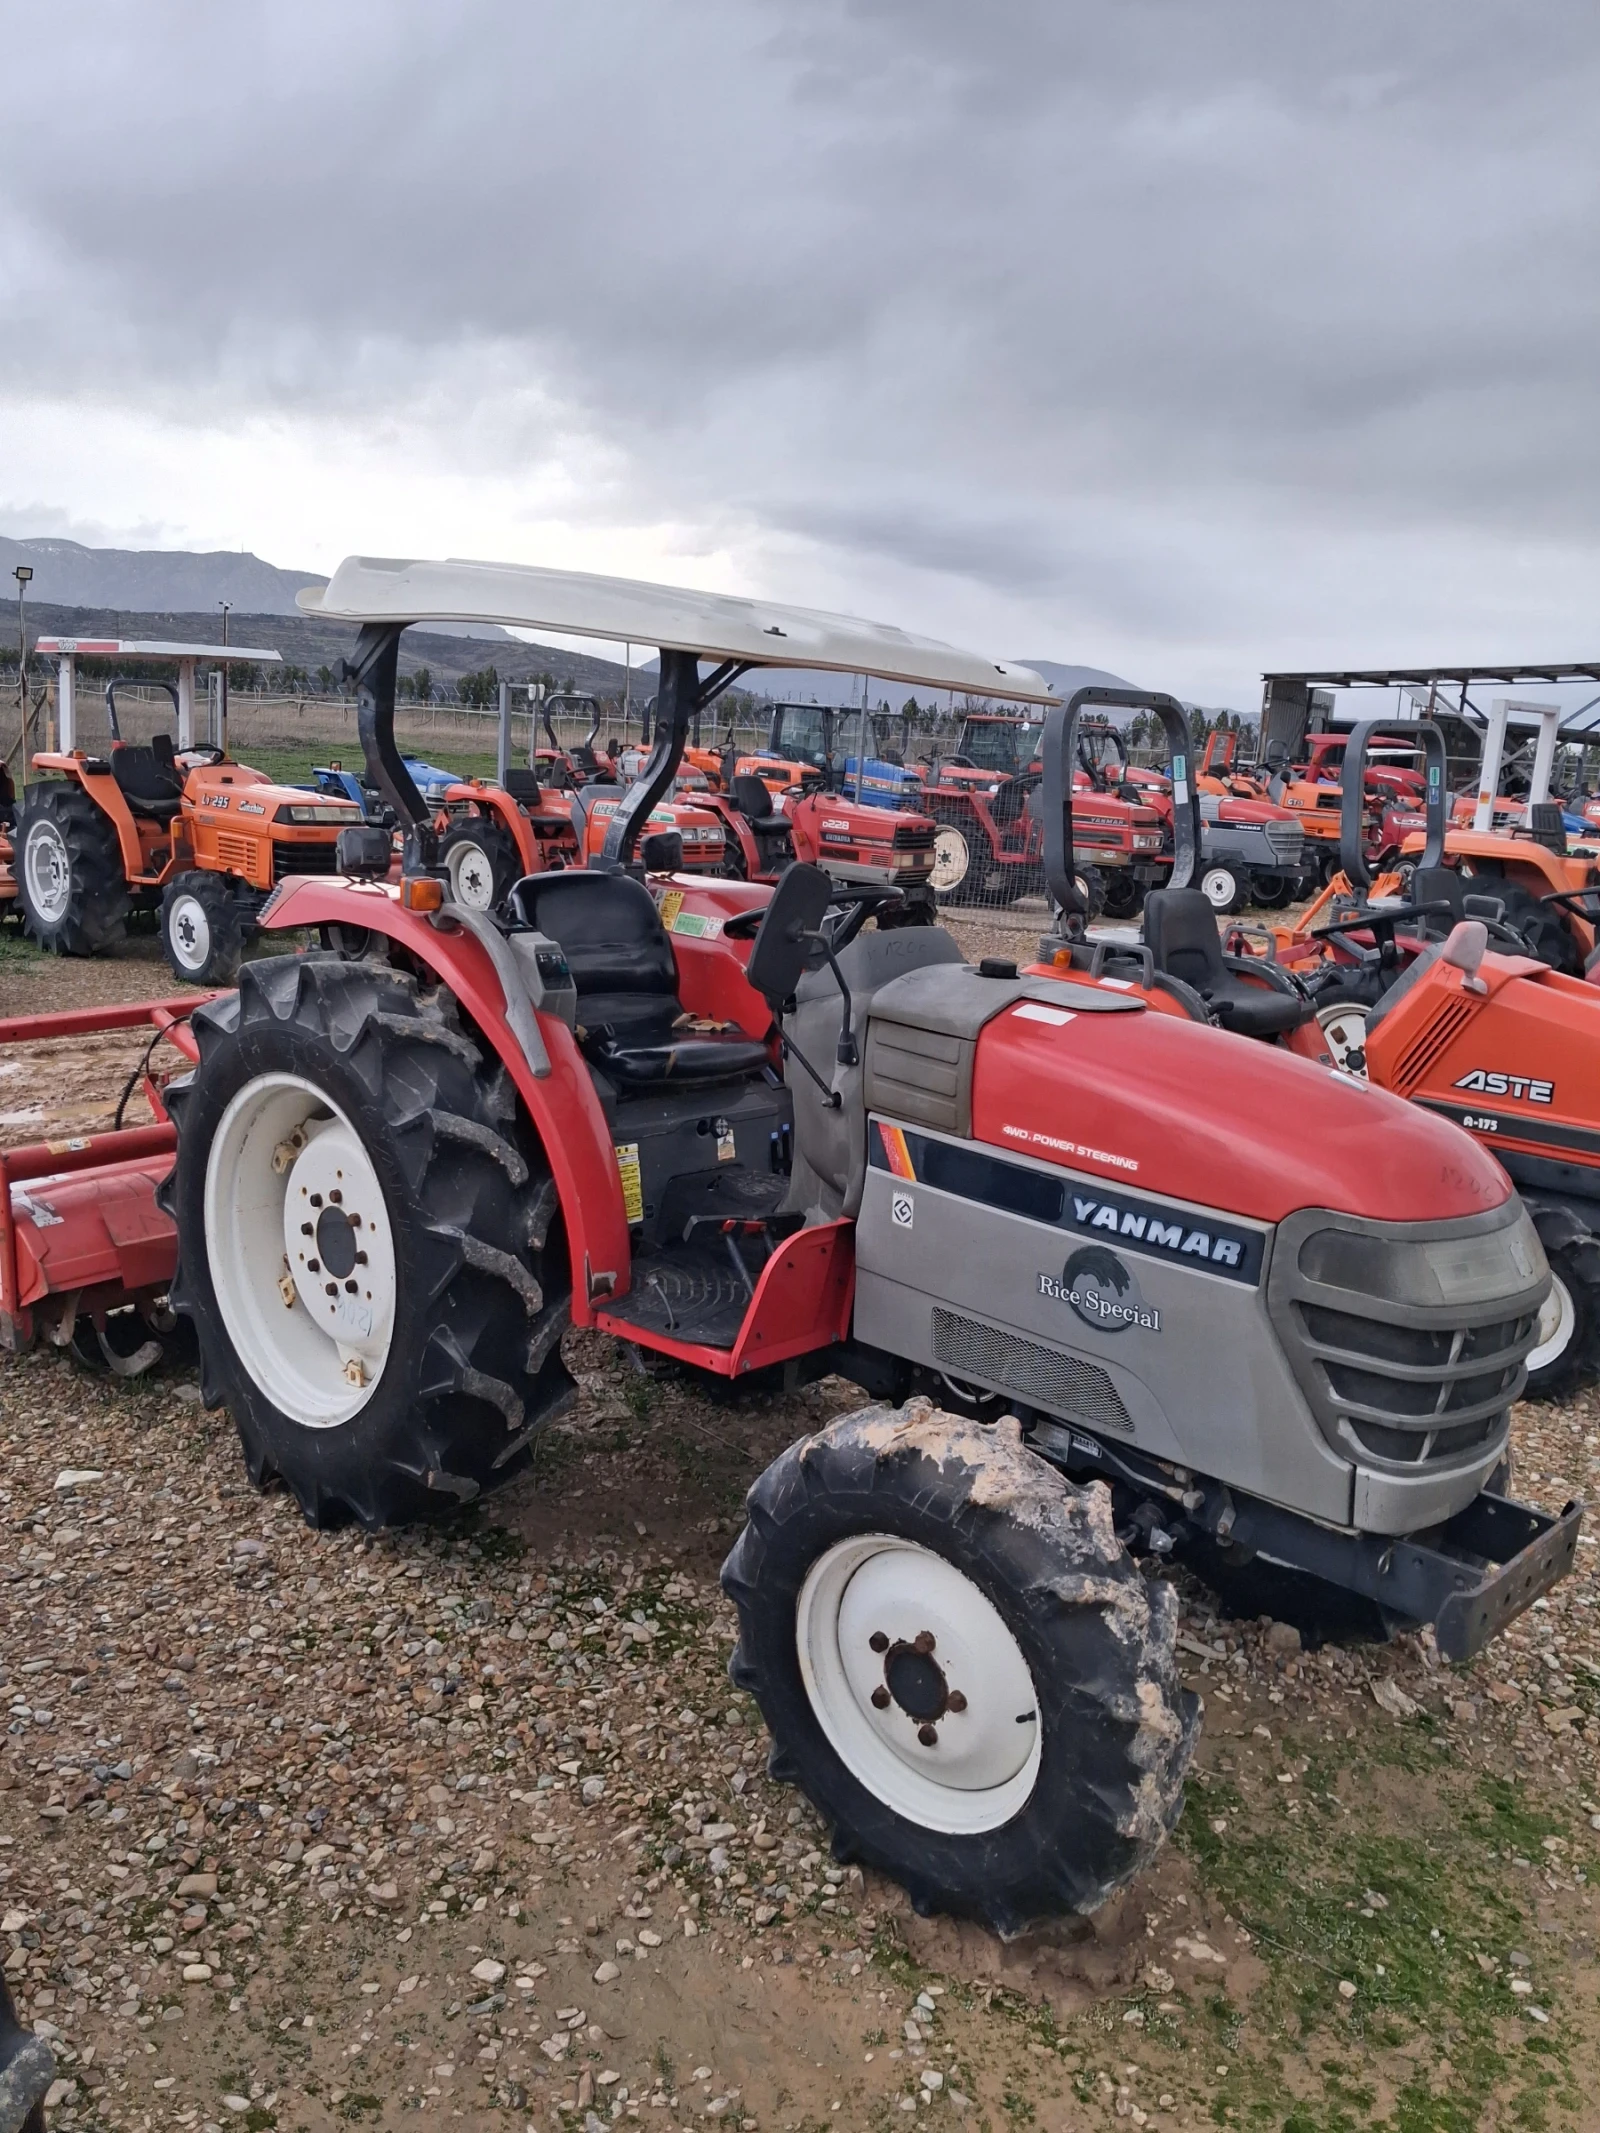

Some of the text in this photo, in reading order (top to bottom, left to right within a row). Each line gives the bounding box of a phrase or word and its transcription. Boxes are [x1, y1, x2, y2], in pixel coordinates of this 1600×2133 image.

[822, 819, 849, 831] D228
[1453, 1069, 1555, 1104] ASTE
[1463, 1115, 1498, 1131] A-175
[1076, 1145, 1140, 1171] STEERING
[1072, 1196, 1243, 1266] YANMAR
[1038, 1273, 1161, 1331] Rice Special
